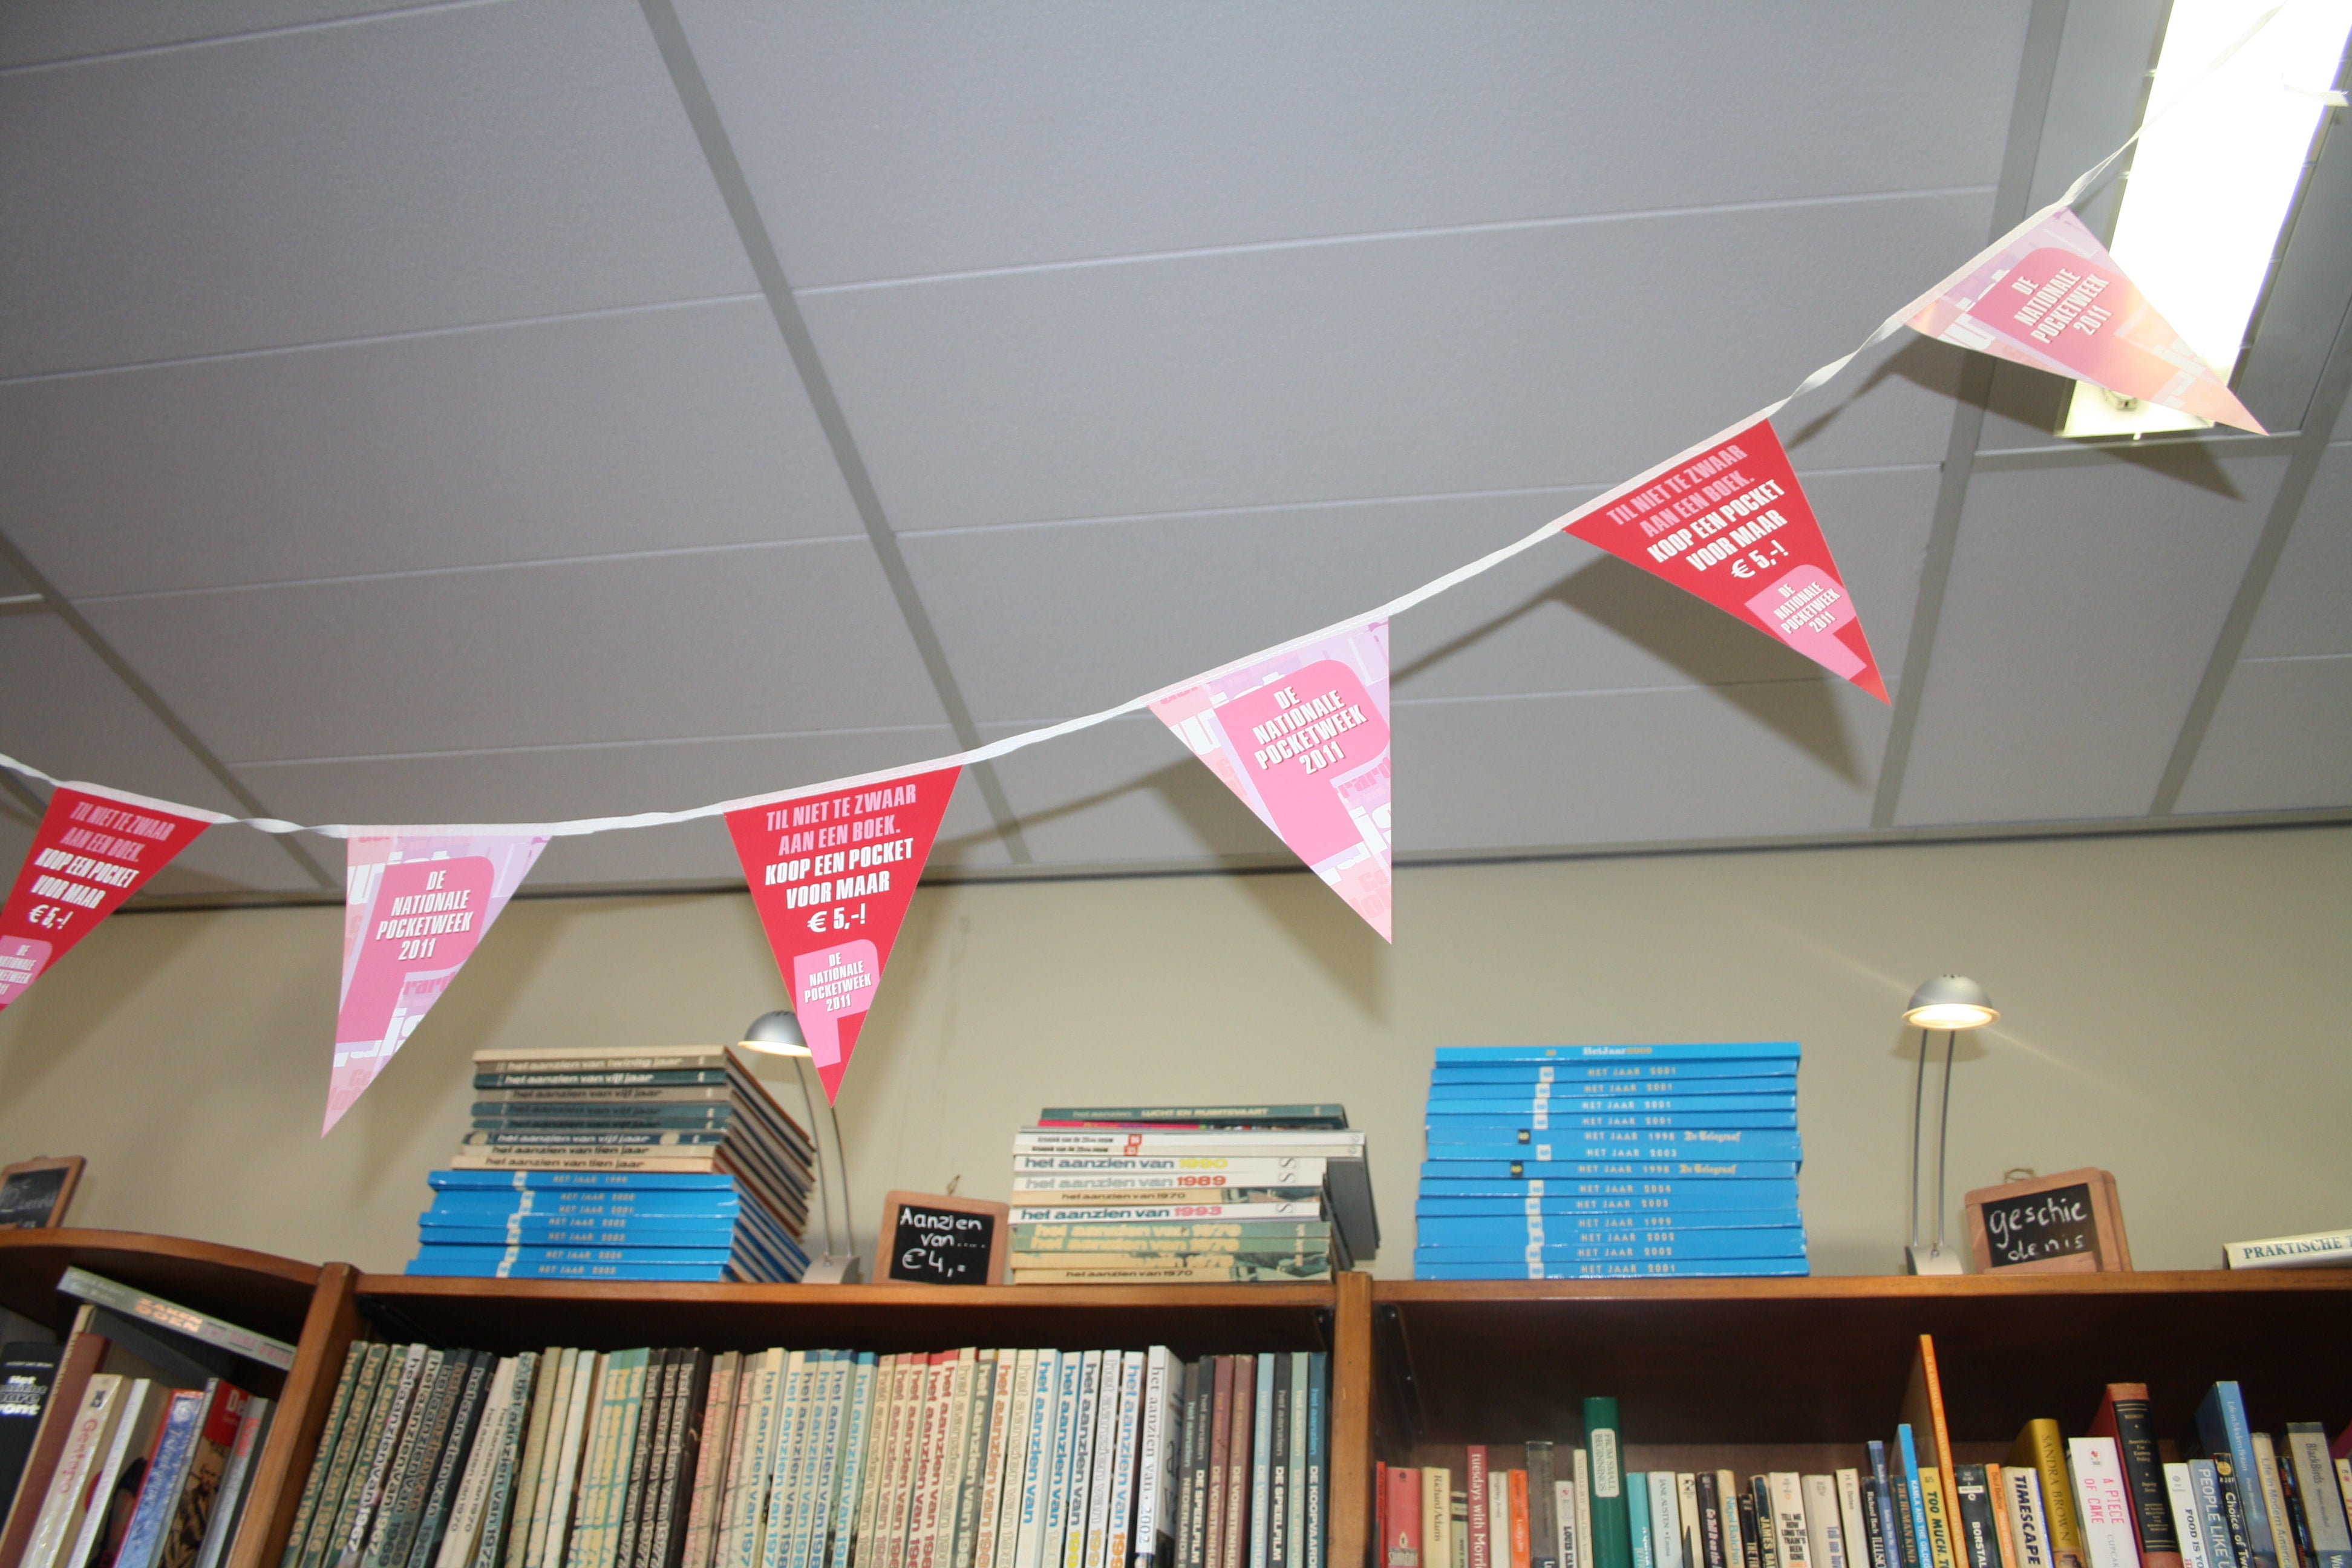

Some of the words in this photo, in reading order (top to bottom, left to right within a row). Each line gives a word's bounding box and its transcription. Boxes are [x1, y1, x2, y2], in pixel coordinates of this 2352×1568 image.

[2011, 276, 2040, 296] DE
[2013, 268, 2082, 327] NATIONALE
[2030, 273, 2111, 344] POCKETWEEK
[2073, 304, 2113, 336] 2011
[1606, 504, 1635, 526] TIL
[1633, 483, 1672, 514] NIET
[1665, 474, 1688, 493] TE
[1683, 444, 1748, 483] ZWAAR
[1639, 508, 1680, 538] AAN
[1676, 491, 1710, 519] EEN
[1702, 470, 1756, 502] BOEK.
[1647, 528, 1694, 563] KOOP
[1690, 512, 1728, 540] EEN
[1720, 479, 1785, 522] POCKET
[1686, 535, 1739, 572] VOOR
[1729, 509, 1789, 550] MAAR
[1731, 558, 1756, 579] €
[1751, 539, 1789, 569] 5,-!
[1773, 581, 1824, 620] NATIONALE
[1777, 583, 1796, 599] DE
[1780, 588, 1841, 634] POCKETWEEK
[1809, 611, 1837, 633] 2011
[1273, 686, 1300, 710] DE
[1252, 690, 1347, 745] NATIONALE
[1255, 704, 1368, 770] POCKETWEEK
[1299, 740, 1347, 775] 2011
[70, 802, 94, 821] TIL
[87, 806, 119, 828] NIET
[114, 812, 131, 831] TE
[126, 815, 175, 841] ZWAAR
[766, 811, 788, 831] TIL
[792, 801, 829, 826] NIET
[832, 797, 850, 817] TE
[854, 783, 916, 814] ZWAAR
[60, 827, 94, 848] AAN
[86, 833, 116, 854] EEN
[108, 838, 145, 863] BOEK.
[778, 830, 814, 856] AAN
[818, 823, 847, 849] EEN
[852, 814, 901, 842] BOEK.
[34, 848, 74, 871] KOOP
[65, 856, 96, 878] EEN
[88, 861, 140, 888] POCKET
[765, 858, 811, 886] KOOP
[814, 851, 845, 877] EEN
[849, 837, 913, 871] POCKET
[31, 875, 71, 899] VOOR
[61, 883, 106, 909] MAAR
[426, 870, 446, 890] DE
[786, 881, 832, 909] VOOR
[836, 871, 890, 901] MAAR
[28, 904, 49, 923] €
[391, 889, 471, 916] NATIONALE
[807, 910, 827, 933] €
[833, 903, 866, 930] 5,-!
[376, 911, 474, 940] POCKETWEEK
[398, 938, 436, 961] 2011
[828, 952, 841, 967] DE
[804, 973, 872, 1003] POCKETWEEK
[809, 960, 864, 987] NATIONALE
[826, 993, 852, 1012] 2011
[1024, 1158, 1057, 1169] het
[1058, 1157, 1138, 1169] aanzien
[1139, 1158, 1175, 1169] van
[1025, 1178, 1057, 1189] het
[1059, 1178, 1138, 1189] aanzien
[1139, 1178, 1174, 1188] van
[1177, 1175, 1226, 1186] 1989
[900, 1207, 982, 1231] Aanzien
[1021, 1209, 1053, 1220] het
[1054, 1208, 1134, 1220] aanzien
[1135, 1208, 1170, 1218] van
[1174, 1206, 1223, 1217] 1993
[2243, 1237, 2342, 1259] PRAKTISCHE
[134, 1304, 200, 1332] DOEN
[1037, 1362, 1051, 1393] het
[1151, 1367, 1164, 1390] het
[1148, 1394, 1160, 1458] aanzien
[2230, 1414, 2236, 1422] in
[1027, 1398, 1045, 1482] aanzien
[1604, 1434, 1613, 1460] FROM
[2232, 1422, 2245, 1448] Modern
[1275, 1466, 1284, 1482] DE
[1595, 1434, 1607, 1492] BEGINNINGS
[2238, 1446, 2248, 1471] Britain
[2306, 1443, 2325, 1485] BlackBirds
[1144, 1464, 1154, 1493] van
[1471, 1453, 1484, 1500] tuesdays
[1607, 1460, 1616, 1491] SMALL
[1897, 1483, 1906, 1499] THE
[2042, 1435, 2057, 1486] SANDRA
[2051, 1491, 2071, 1541] BROWN
[2084, 1478, 2097, 1491] OF
[2261, 1457, 2272, 1476] Life
[2268, 1489, 2282, 1526] Modern
[1023, 1486, 1036, 1524] van
[1434, 1475, 1443, 1511] Richard
[1911, 1480, 1921, 1505] KAMLA
[1927, 1491, 1939, 1513] TOO
[2105, 1489, 2125, 1525] PIECE
[1272, 1486, 1284, 1561] SPEELFILM
[1473, 1504, 1486, 1529] with
[1661, 1496, 1670, 1528] AUSTEN
[1726, 1497, 1737, 1524] Nigel
[1900, 1501, 1912, 1537] HUMAN
[1915, 1508, 1924, 1523] AND
[2013, 1475, 2041, 1566] TIMESCAPE
[2088, 1498, 2105, 1524] CAKE
[2198, 1468, 2221, 1521] PEOPLE
[2210, 1526, 2229, 1558] LIKE
[2225, 1492, 2240, 1529] Choice
[2235, 1535, 2246, 1546] of
[1434, 1512, 1443, 1542] Adams
[2185, 1509, 2198, 1538] FOOD
[2192, 1541, 2200, 1552] IS
[1728, 1524, 1740, 1565] Balchin
[1906, 1536, 1916, 1564] KIND
[1971, 1521, 1987, 1568] BORSTAL
